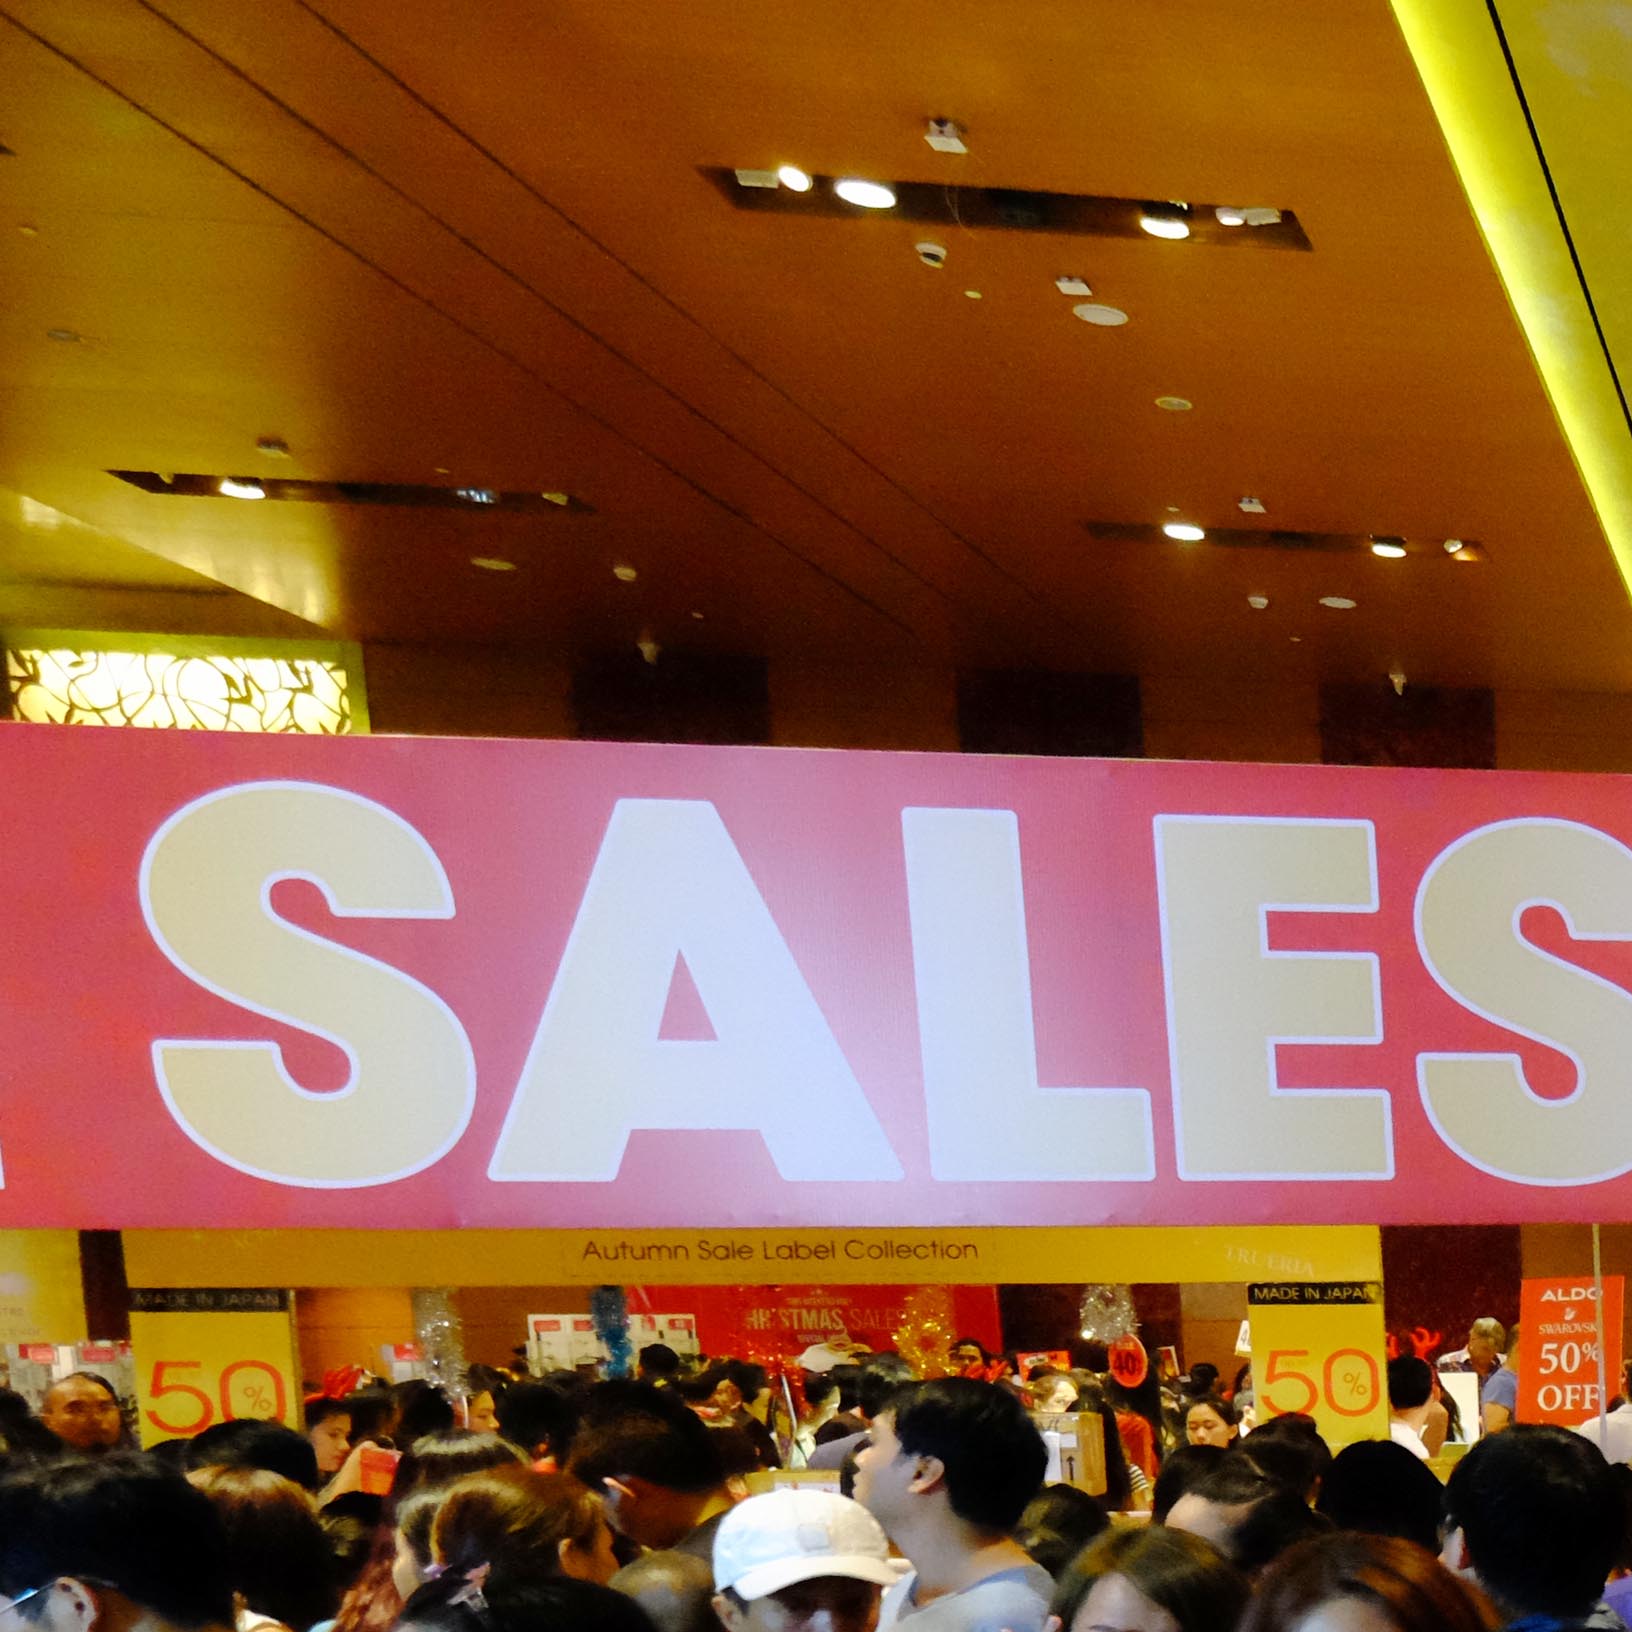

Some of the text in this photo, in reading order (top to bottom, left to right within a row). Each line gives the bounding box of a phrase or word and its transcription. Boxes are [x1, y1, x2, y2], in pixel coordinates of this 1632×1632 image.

[582, 1239, 979, 1261] Autumn Sale Label Collection
[1254, 1286, 1374, 1300] MADE IN JAPAN
[1540, 1287, 1604, 1303] ALDO
[1538, 1323, 1600, 1335] SWAROVSK
[1538, 1341, 1601, 1375] 50%
[1261, 1347, 1381, 1418] 50
[145, 1359, 287, 1435] 50
[1537, 1384, 1606, 1412] OFF
